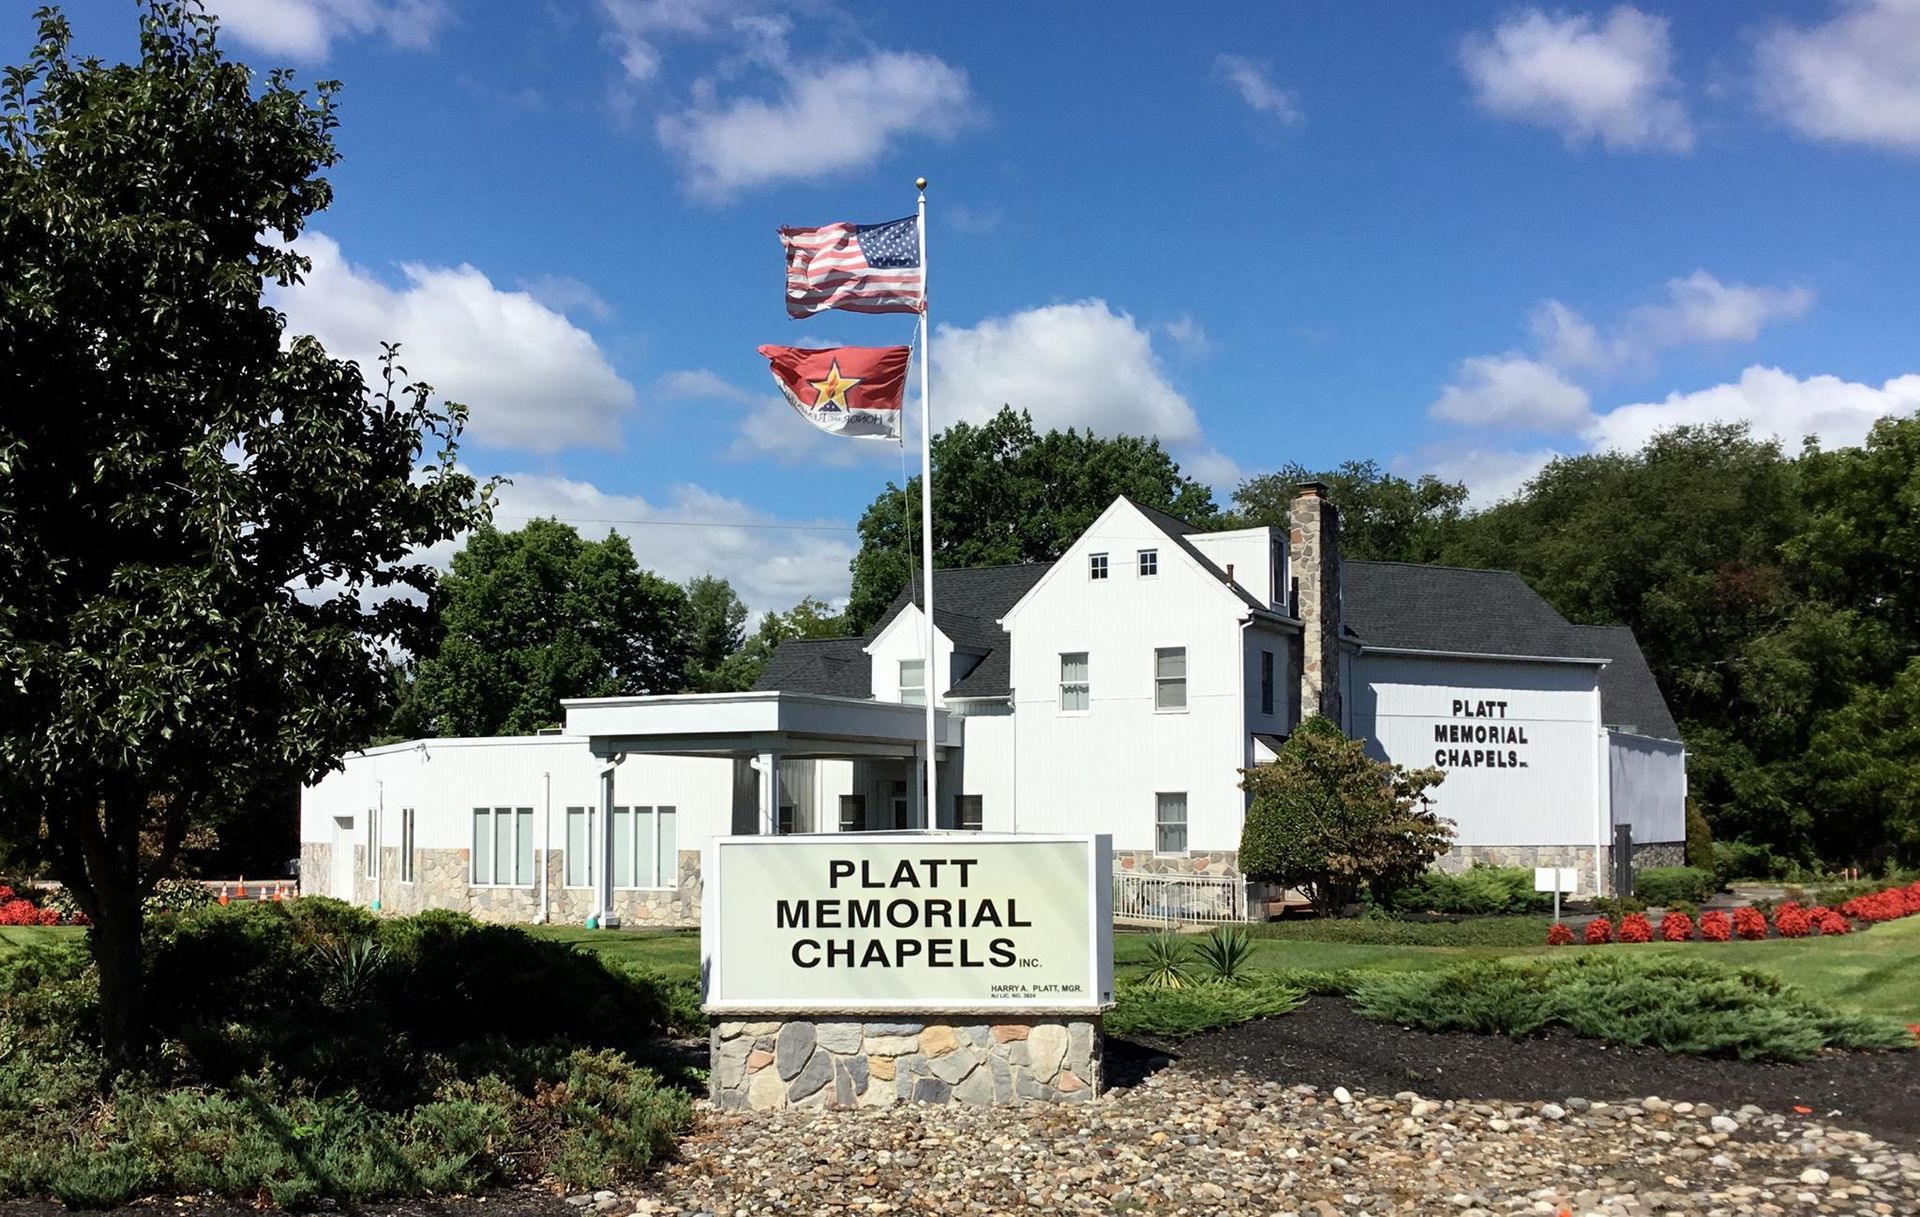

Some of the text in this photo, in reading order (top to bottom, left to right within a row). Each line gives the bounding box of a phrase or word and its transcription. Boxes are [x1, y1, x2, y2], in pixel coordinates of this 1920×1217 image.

[1453, 699, 1508, 718] PLATT
[1435, 725, 1528, 744] MEMORIAL
[1435, 749, 1518, 768] CHAPELS
[829, 859, 977, 888] PLATT
[776, 898, 1032, 929] MEMORIAL
[791, 938, 1043, 968] CHAPELS INC.
[991, 984, 1019, 992] HARRY
